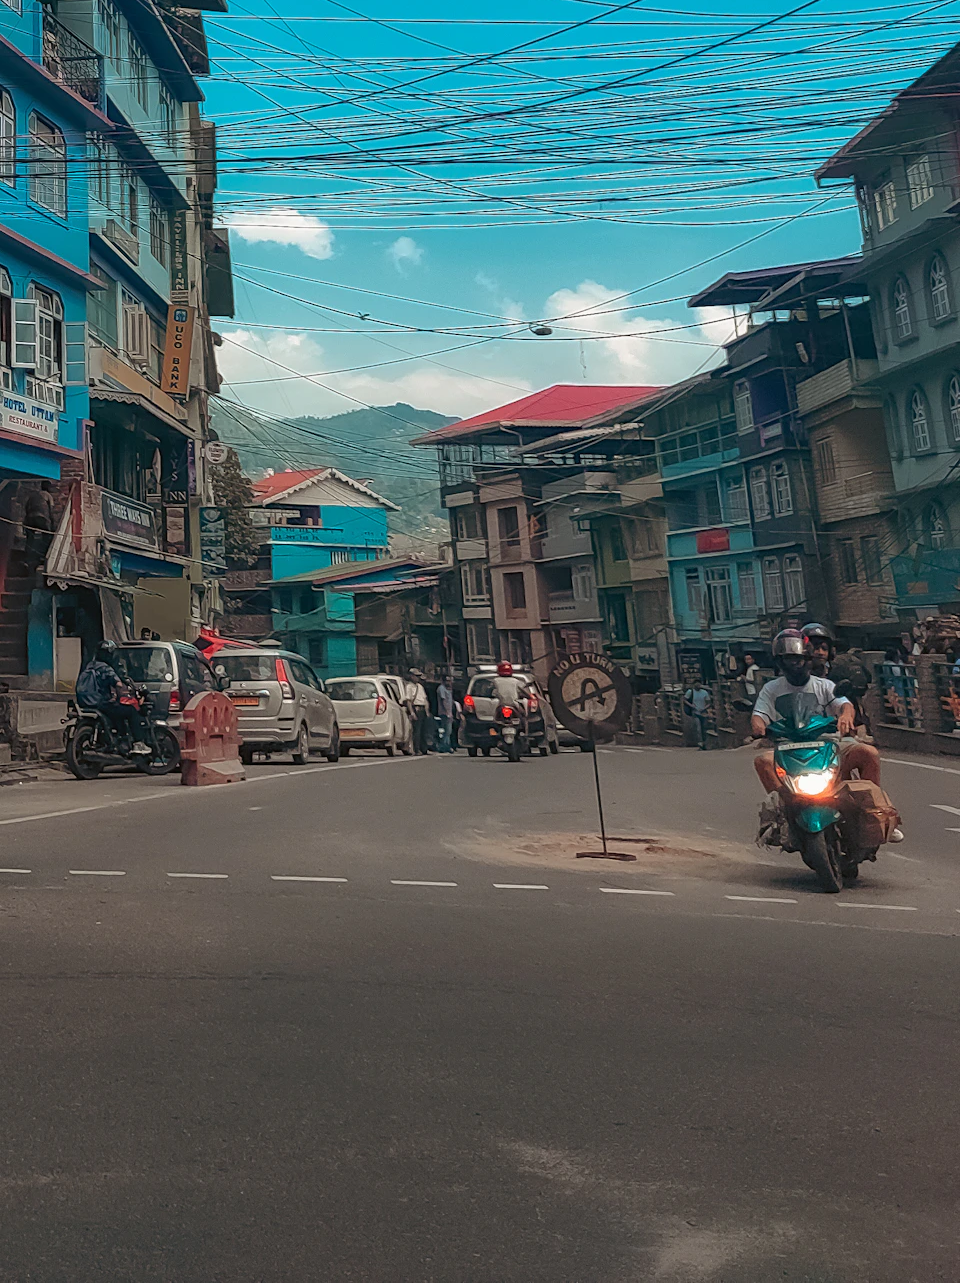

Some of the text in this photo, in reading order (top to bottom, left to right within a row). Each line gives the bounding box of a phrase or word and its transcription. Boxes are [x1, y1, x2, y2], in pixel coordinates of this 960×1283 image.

[170, 325, 184, 389] UCO BANK
[3, 397, 55, 423] HOTEL UTTAM
[8, 415, 43, 432] RESTAURANT
[163, 488, 187, 501] INN
[110, 500, 128, 521] THREE
[553, 652, 617, 677] NO U TURN
